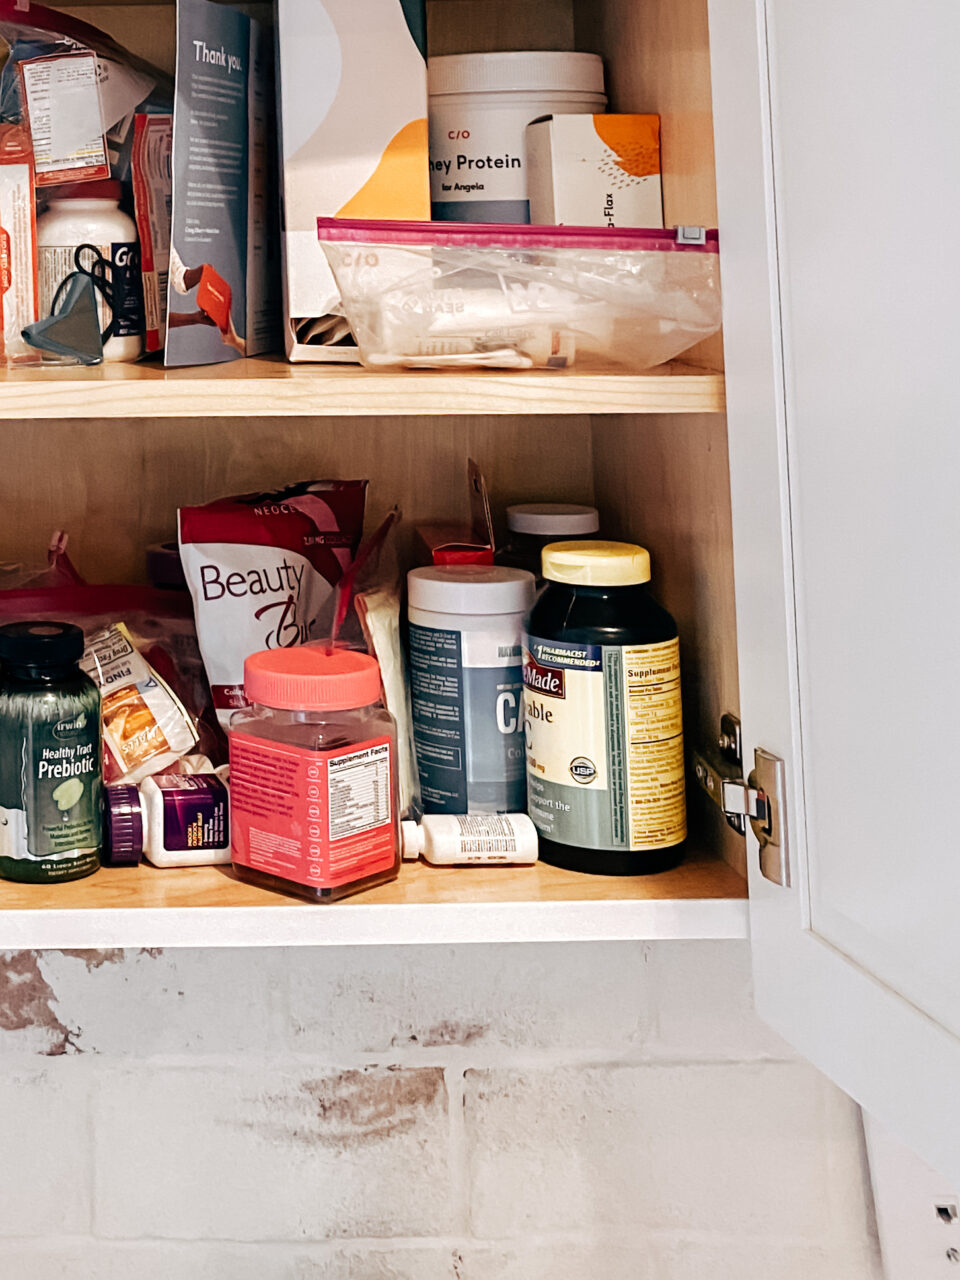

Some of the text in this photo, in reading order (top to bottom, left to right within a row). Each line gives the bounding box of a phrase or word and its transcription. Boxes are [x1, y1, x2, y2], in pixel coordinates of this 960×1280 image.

[192, 39, 227, 67] Thank
[447, 130, 471, 140] C/O
[456, 154, 522, 170] Protein
[454, 182, 485, 194] Angela
[200, 558, 304, 602] Beauty
[113, 644, 130, 658] Drug
[543, 646, 588, 658] PHARMACIST
[106, 667, 132, 684] FIND
[57, 719, 83, 731] irwin
[42, 742, 93, 762] Healthy Tract
[329, 746, 389, 768] Supplement Facts
[38, 755, 95, 779] Prebiotic
[571, 766, 596, 776] USP
[554, 800, 572, 812] the
[49, 832, 70, 840] Maintain
